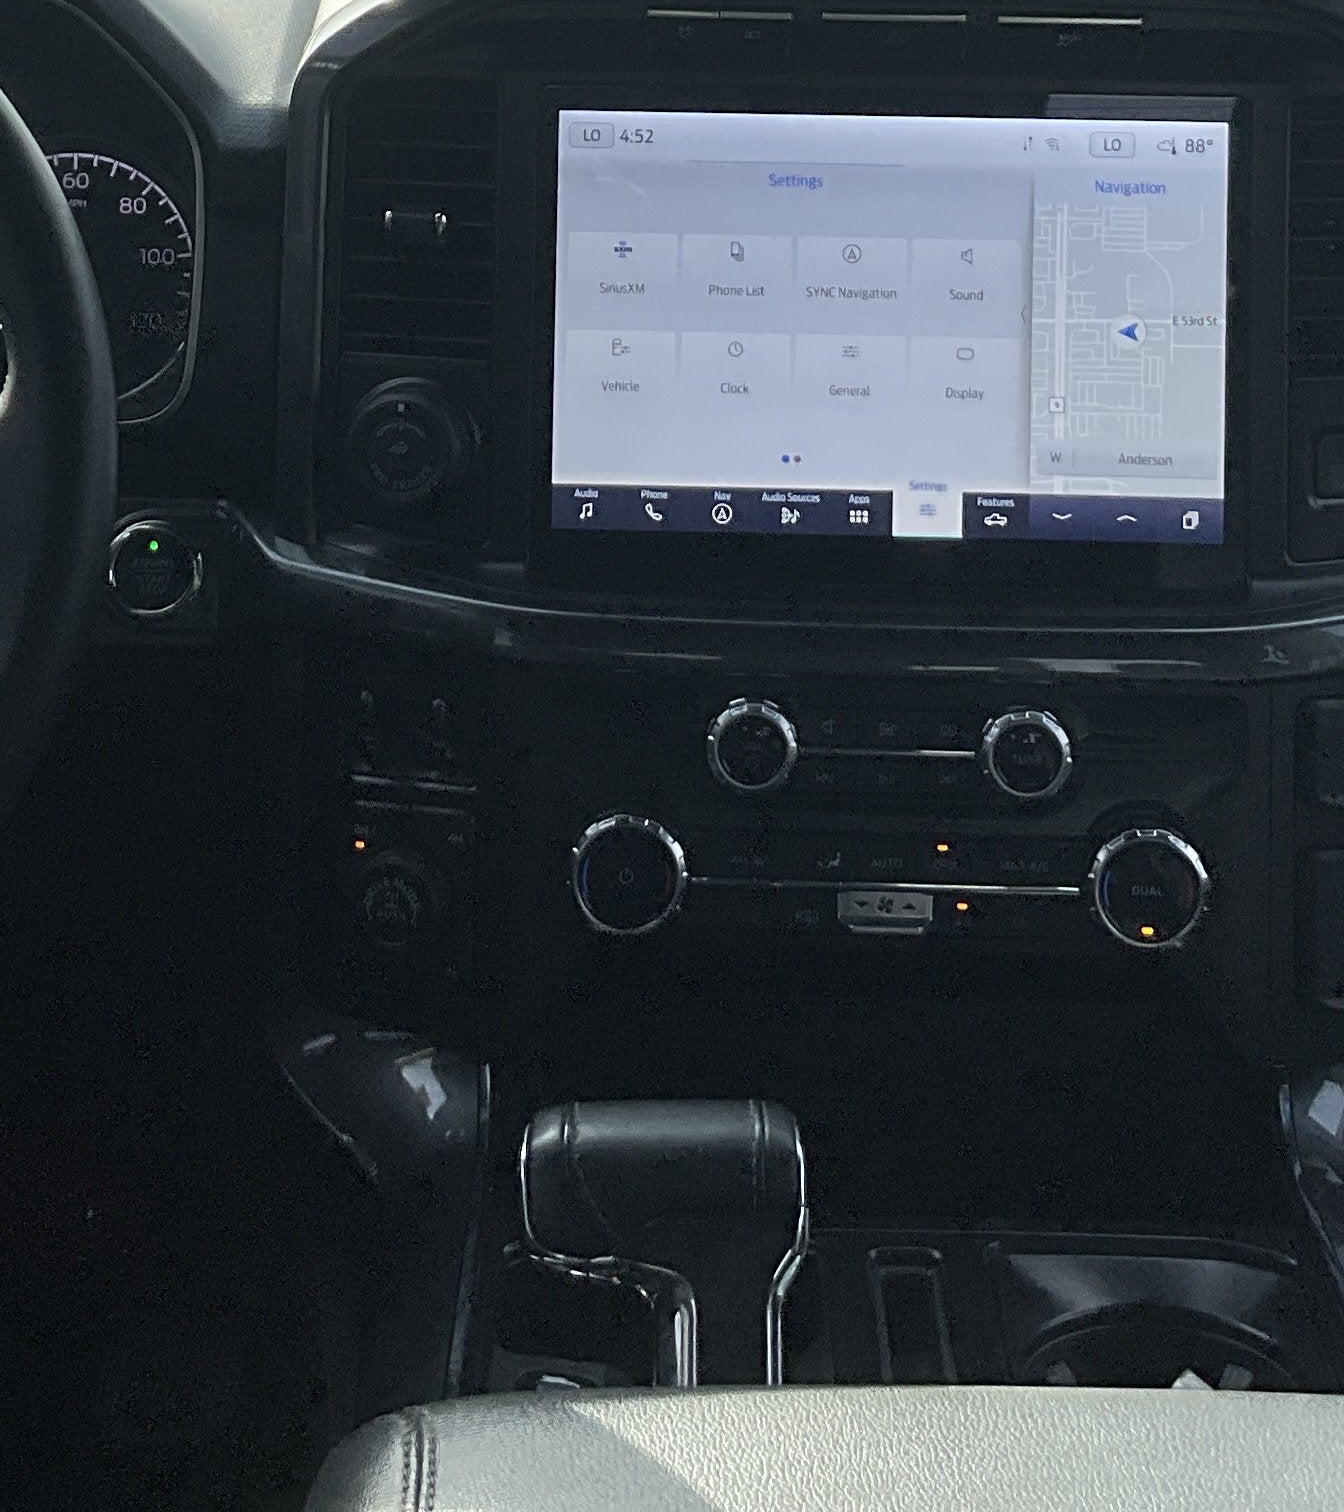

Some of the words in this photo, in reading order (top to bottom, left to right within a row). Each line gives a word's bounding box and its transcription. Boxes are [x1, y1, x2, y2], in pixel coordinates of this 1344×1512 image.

[584, 129, 601, 142] LO
[619, 129, 654, 144] 4:52
[1103, 138, 1122, 152] LO
[62, 172, 89, 189] 60
[768, 173, 824, 189] Settings
[1094, 180, 1167, 197] Navigation
[119, 197, 147, 214] 80
[140, 248, 175, 265] 100
[708, 284, 744, 296] Phone
[746, 285, 764, 296] List
[805, 286, 835, 298] SYNC
[838, 286, 897, 301] Navigation
[949, 289, 984, 301] Sound
[1173, 316, 1179, 326] E
[1181, 316, 1204, 326] 53rd
[1206, 316, 1217, 326] St
[601, 380, 640, 392] Vehicle
[720, 382, 749, 394] Clock
[828, 384, 870, 396] General
[945, 386, 984, 400] Display
[1050, 452, 1062, 464] W
[1118, 452, 1172, 466] Anderson
[908, 479, 948, 492] Settings
[574, 488, 599, 498] Audio
[640, 490, 669, 500] Phone
[714, 491, 732, 500] Nav
[761, 492, 786, 502] Audio
[787, 492, 821, 503] Sources
[848, 493, 870, 505] Apps
[977, 497, 1015, 507] Features
